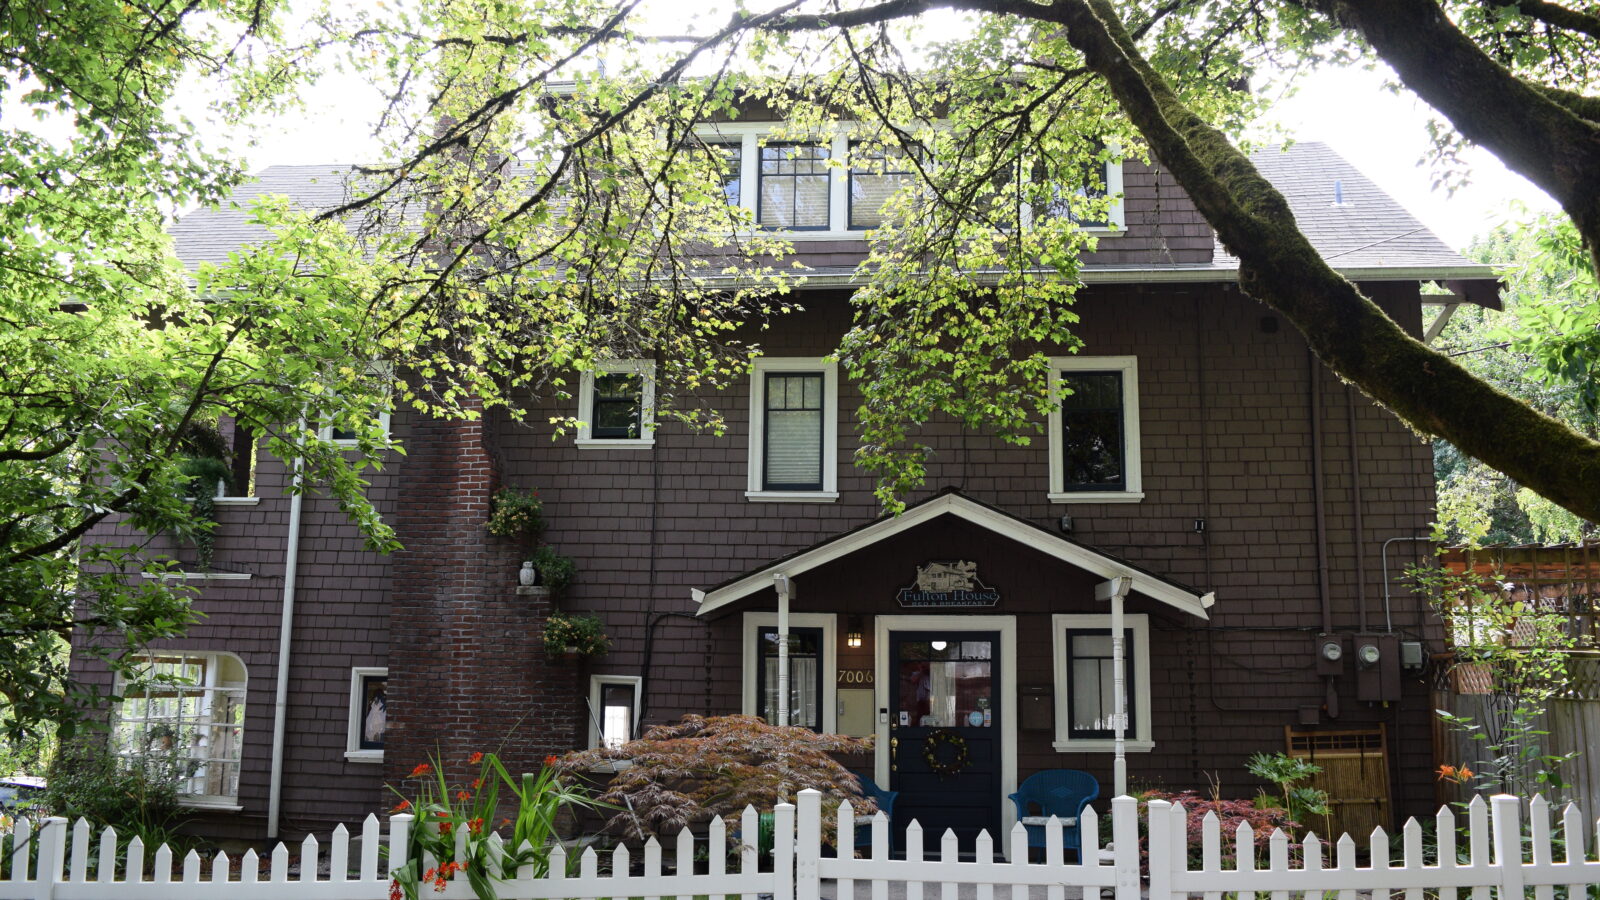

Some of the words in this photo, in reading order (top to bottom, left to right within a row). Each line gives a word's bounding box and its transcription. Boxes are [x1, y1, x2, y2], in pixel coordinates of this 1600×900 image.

[903, 590, 948, 601] Fulton
[953, 590, 997, 601] House
[838, 670, 873, 683] 7006
